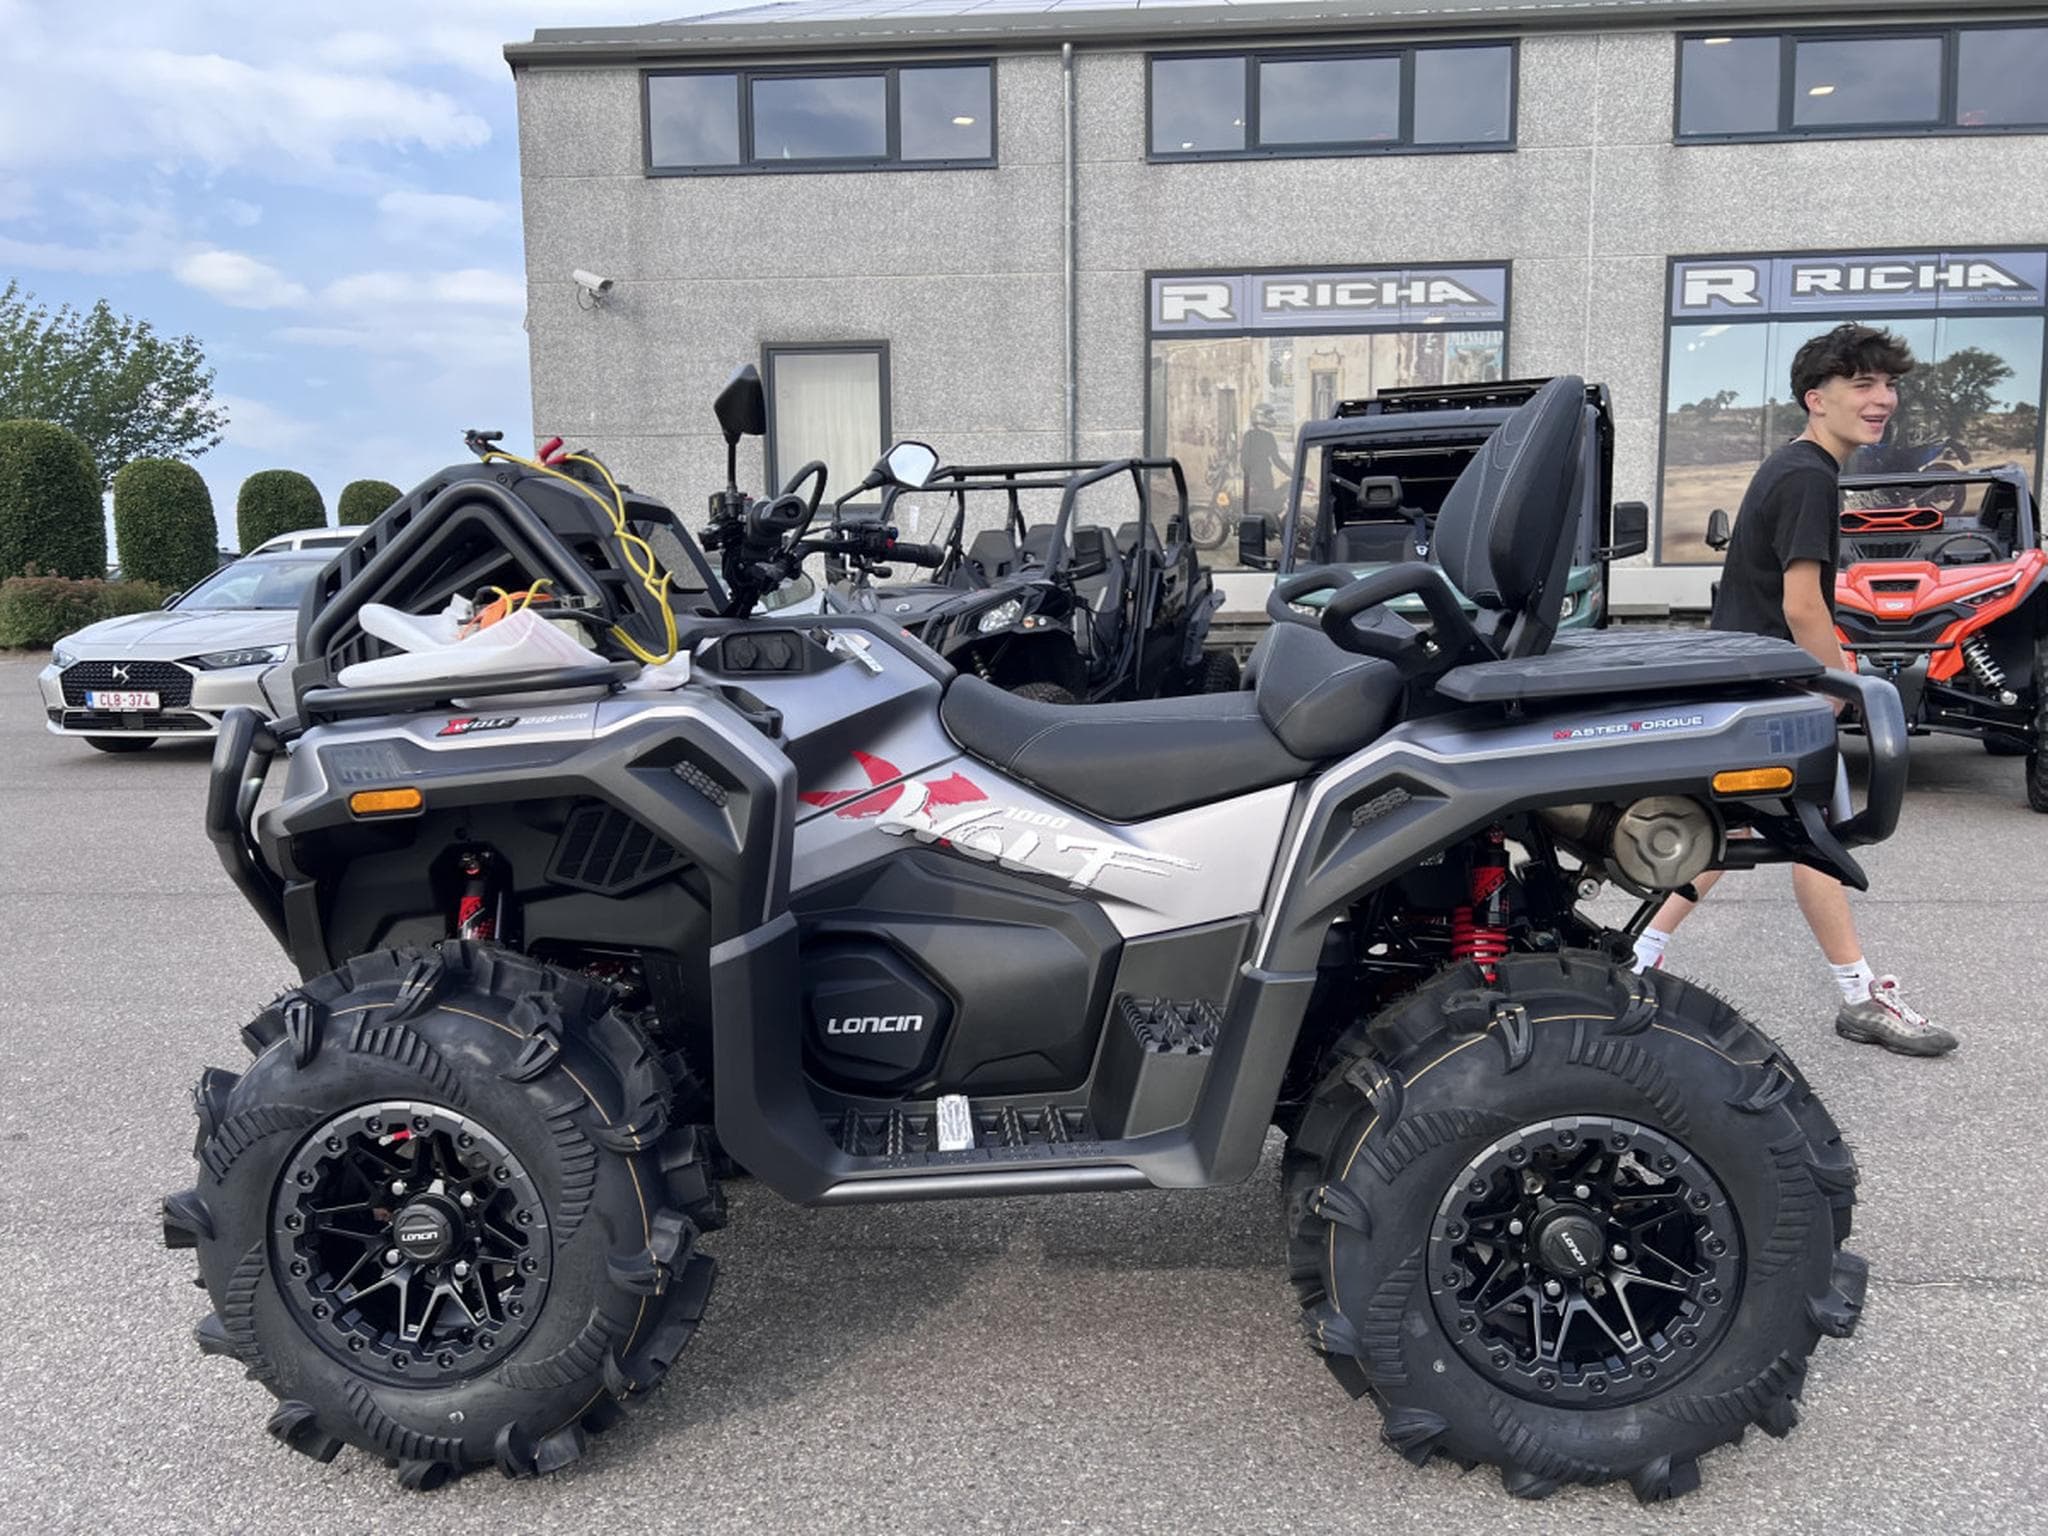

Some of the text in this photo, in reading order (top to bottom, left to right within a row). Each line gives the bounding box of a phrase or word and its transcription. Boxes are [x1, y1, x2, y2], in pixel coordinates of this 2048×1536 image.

[1683, 262, 2022, 306] R RICHA
[1161, 278, 1482, 322] R RICHA
[1552, 716, 1704, 740] MASTER TORQUE
[1003, 805, 1072, 830] 1000
[827, 1014, 923, 1035] LONCIN
[401, 1231, 439, 1242] LONCIN
